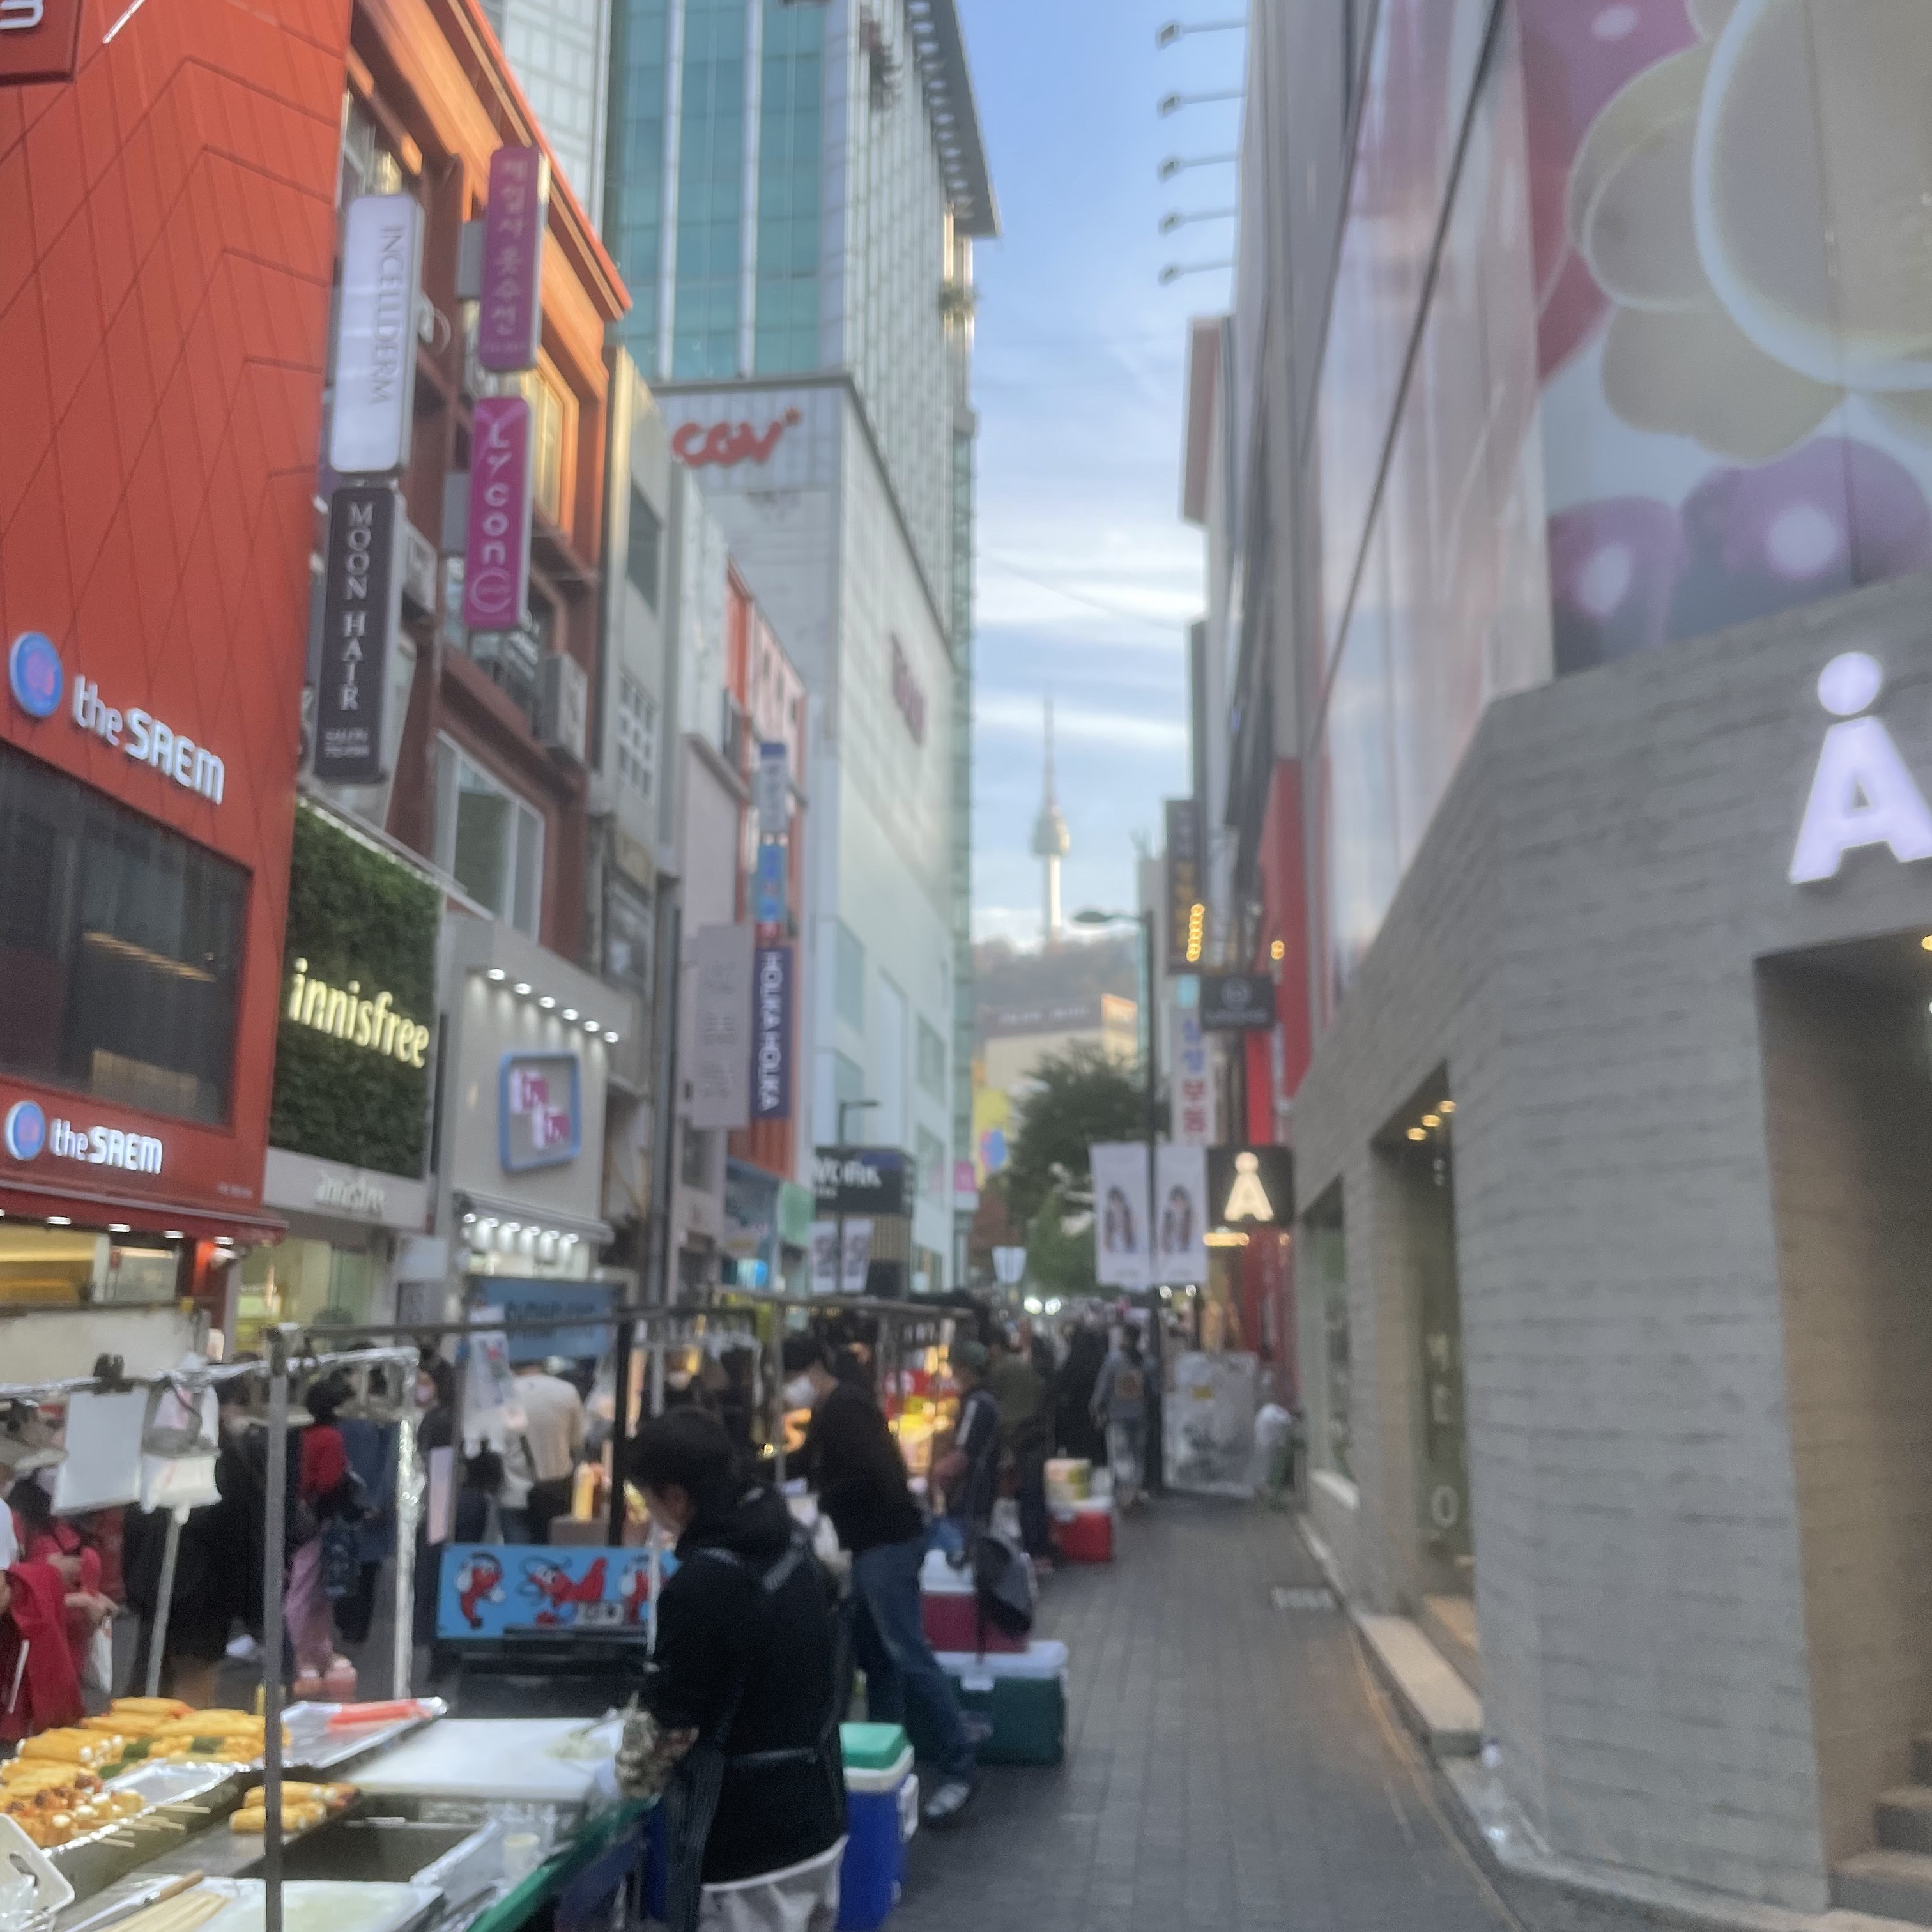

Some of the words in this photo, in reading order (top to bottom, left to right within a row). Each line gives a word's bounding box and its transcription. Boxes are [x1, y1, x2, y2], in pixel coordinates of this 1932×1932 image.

[673, 421, 783, 468] CGV
[347, 502, 372, 600] MOON
[341, 611, 367, 710] HAIR
[73, 674, 123, 746] the
[288, 957, 429, 1068] innisfree
[50, 1118, 88, 1160] the
